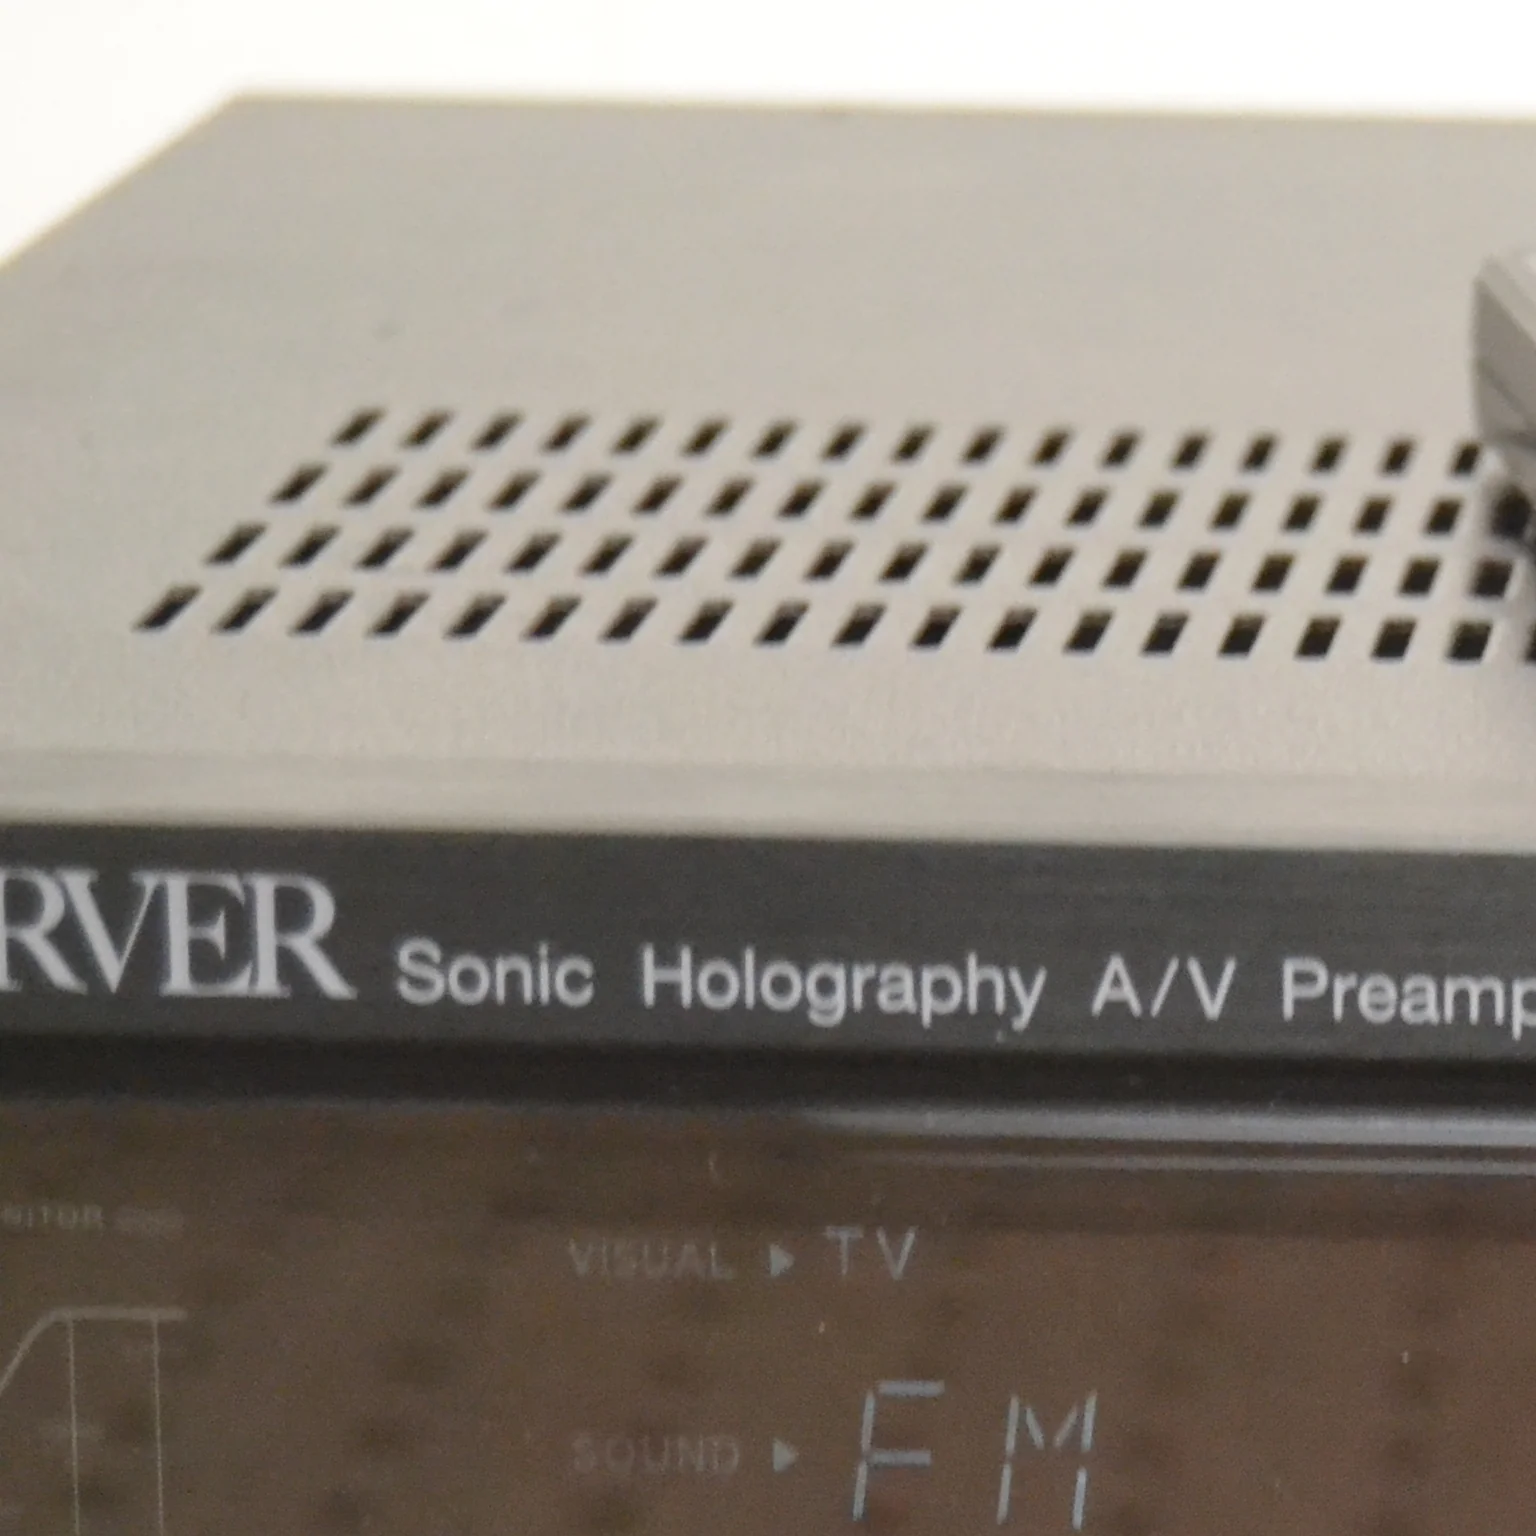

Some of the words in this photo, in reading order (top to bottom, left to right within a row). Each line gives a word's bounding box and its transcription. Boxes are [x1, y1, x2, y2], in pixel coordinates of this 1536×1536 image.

[0, 866, 357, 1000] RVER
[397, 937, 595, 1006] Sonic
[641, 944, 1046, 1029] Holography
[1092, 954, 1237, 1019] A/V
[824, 1225, 919, 1281] TV
